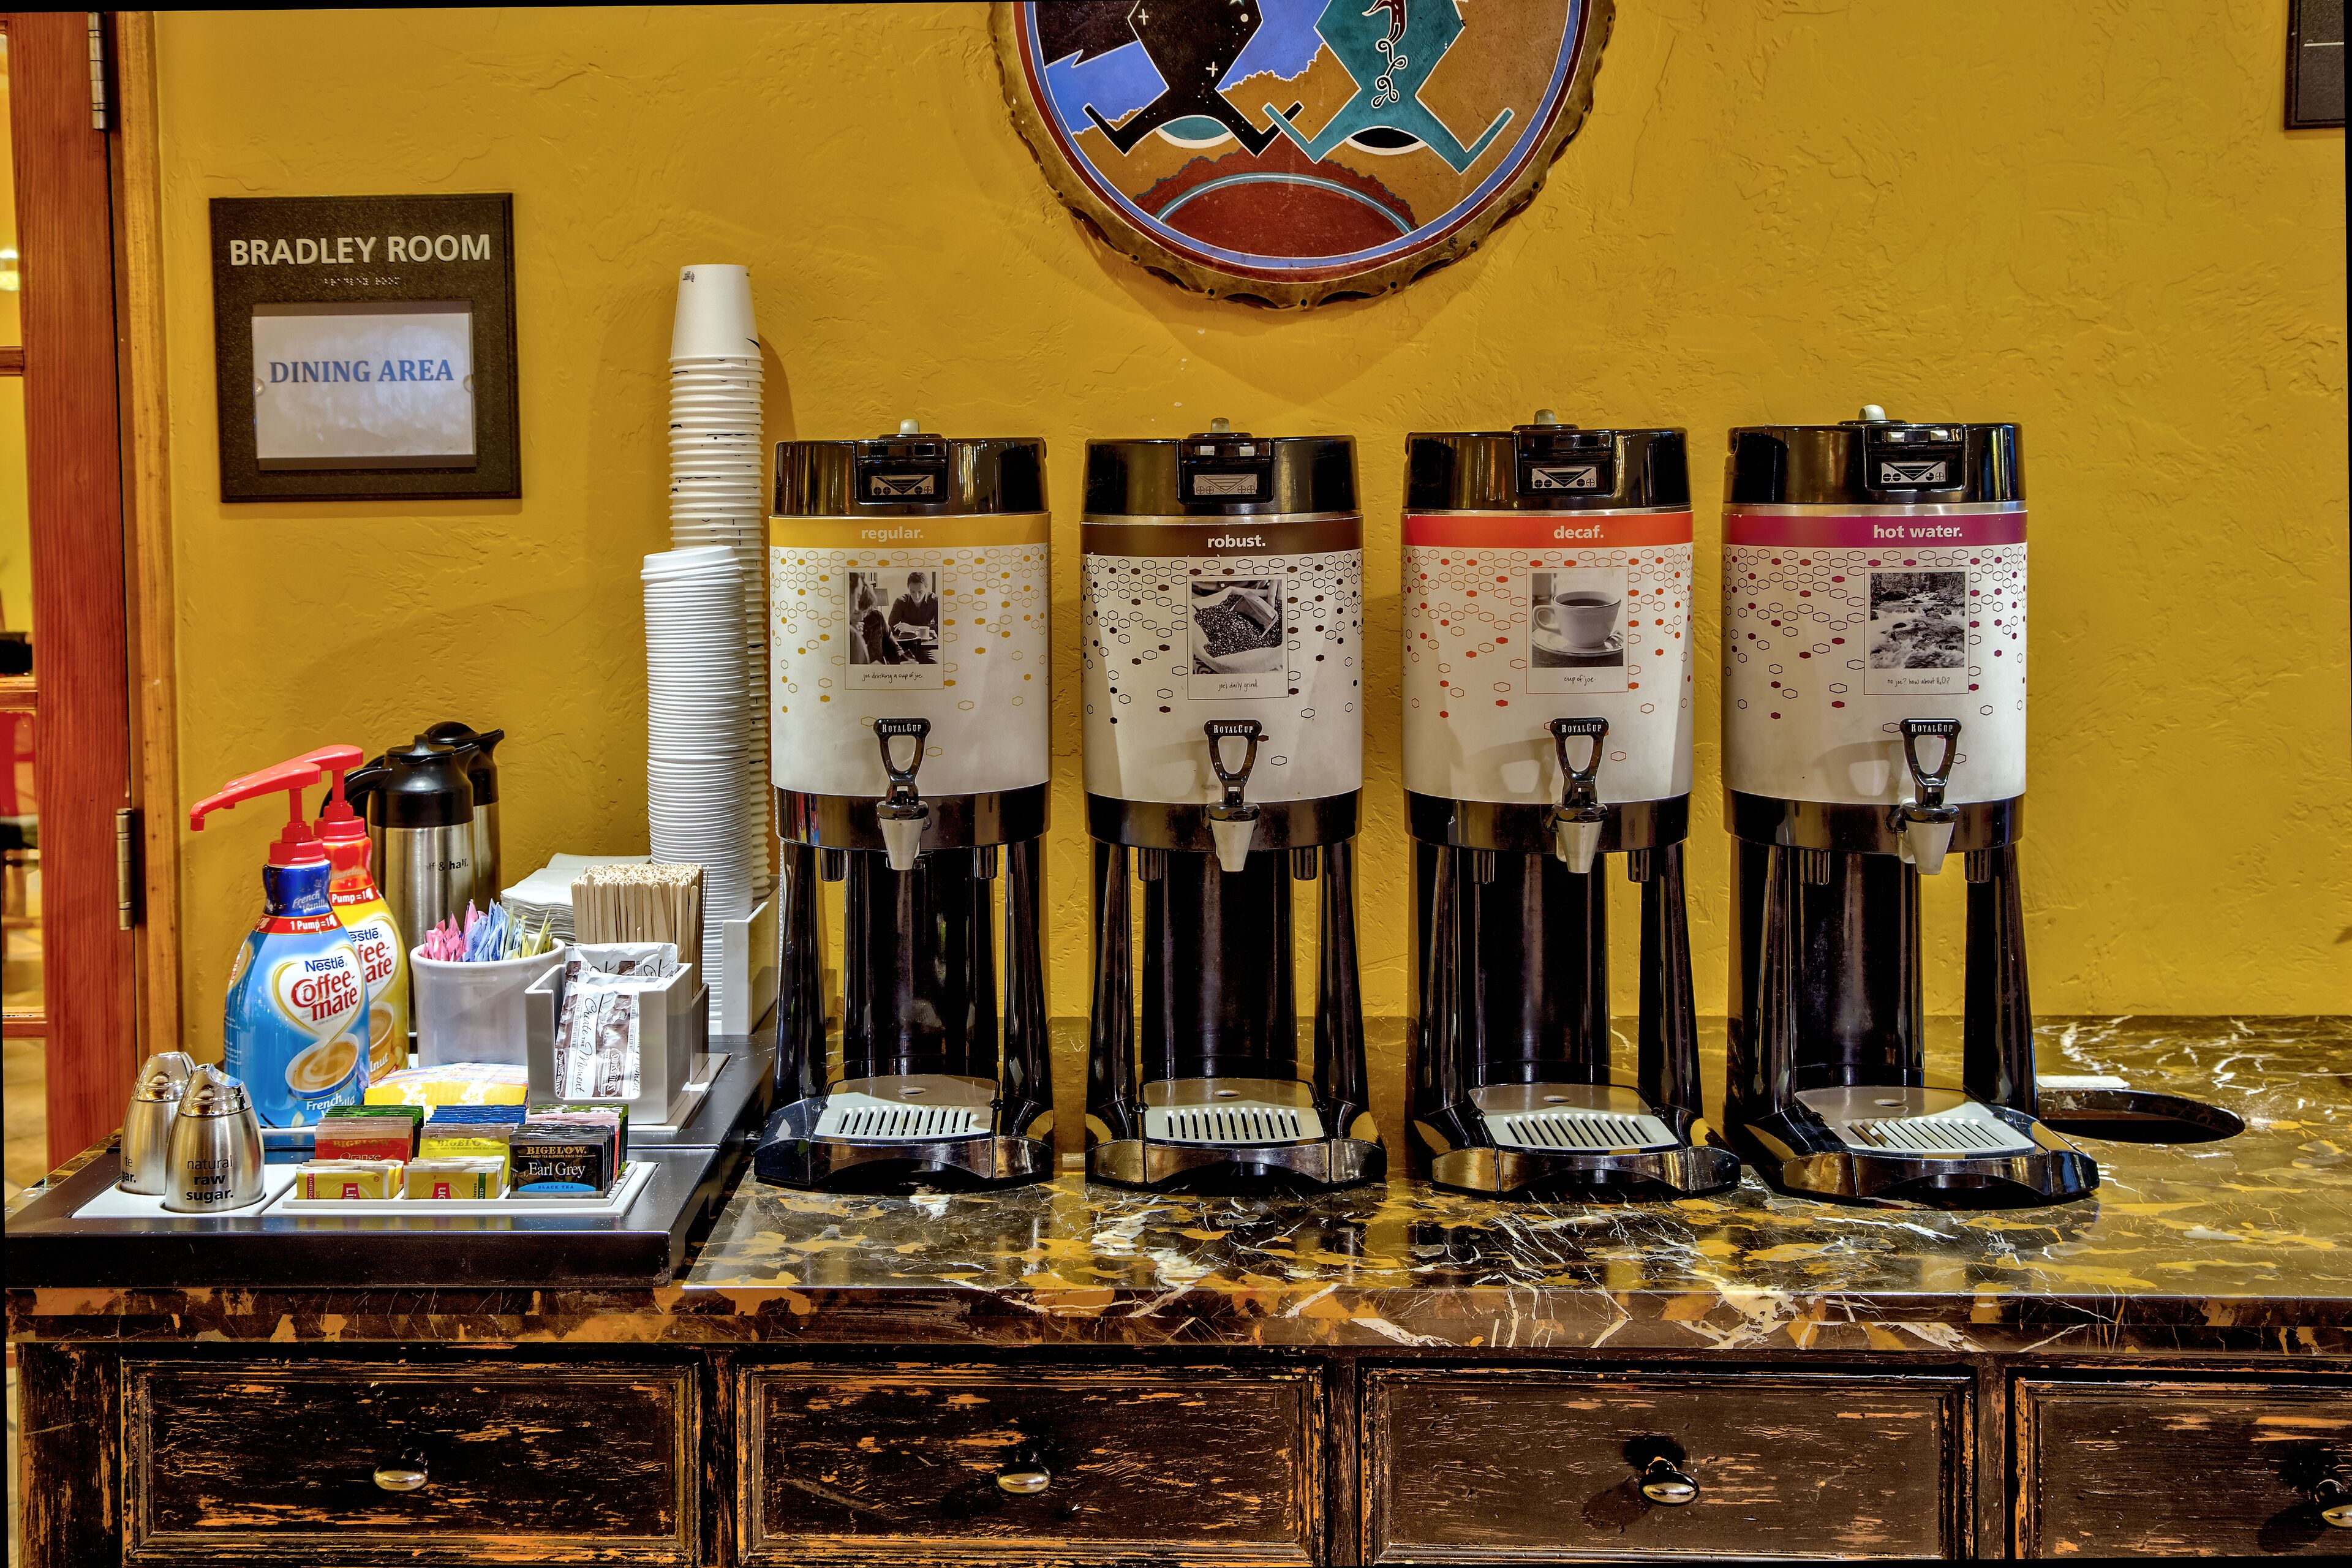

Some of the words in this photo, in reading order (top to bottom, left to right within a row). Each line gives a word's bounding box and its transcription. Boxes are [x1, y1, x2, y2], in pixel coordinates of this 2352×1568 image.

[229, 236, 376, 266] BRADLEY
[388, 233, 491, 263] ROOM
[270, 360, 371, 384] DINING
[379, 359, 454, 382] AREA
[862, 526, 924, 542] regular.
[1553, 524, 1604, 539] decaf.
[1874, 524, 1904, 538] hot
[1909, 524, 1962, 538] water.
[1207, 534, 1265, 548] robust.
[872, 672, 892, 684] drinking
[1895, 678, 1907, 687] joe?
[1218, 681, 1227, 692] joe's
[1229, 682, 1242, 690] daily
[439, 861, 445, 871] &
[449, 858, 469, 870] half.
[292, 889, 321, 909] French
[349, 928, 379, 942] estlé
[358, 941, 390, 963] fee-
[304, 956, 344, 973] Nestlé
[366, 957, 392, 983] ate
[311, 987, 358, 1021] mate
[582, 998, 597, 1037] Create
[370, 1052, 388, 1072] lnut
[576, 1041, 593, 1093] Moment
[306, 1093, 342, 1110] French
[340, 1152, 381, 1161] Orange
[527, 1146, 586, 1155] BIGELOW
[187, 1155, 233, 1170] natural
[529, 1162, 552, 1175] Earl
[556, 1162, 586, 1178] Grey
[194, 1175, 226, 1185] raw
[186, 1188, 234, 1204] sugar.
